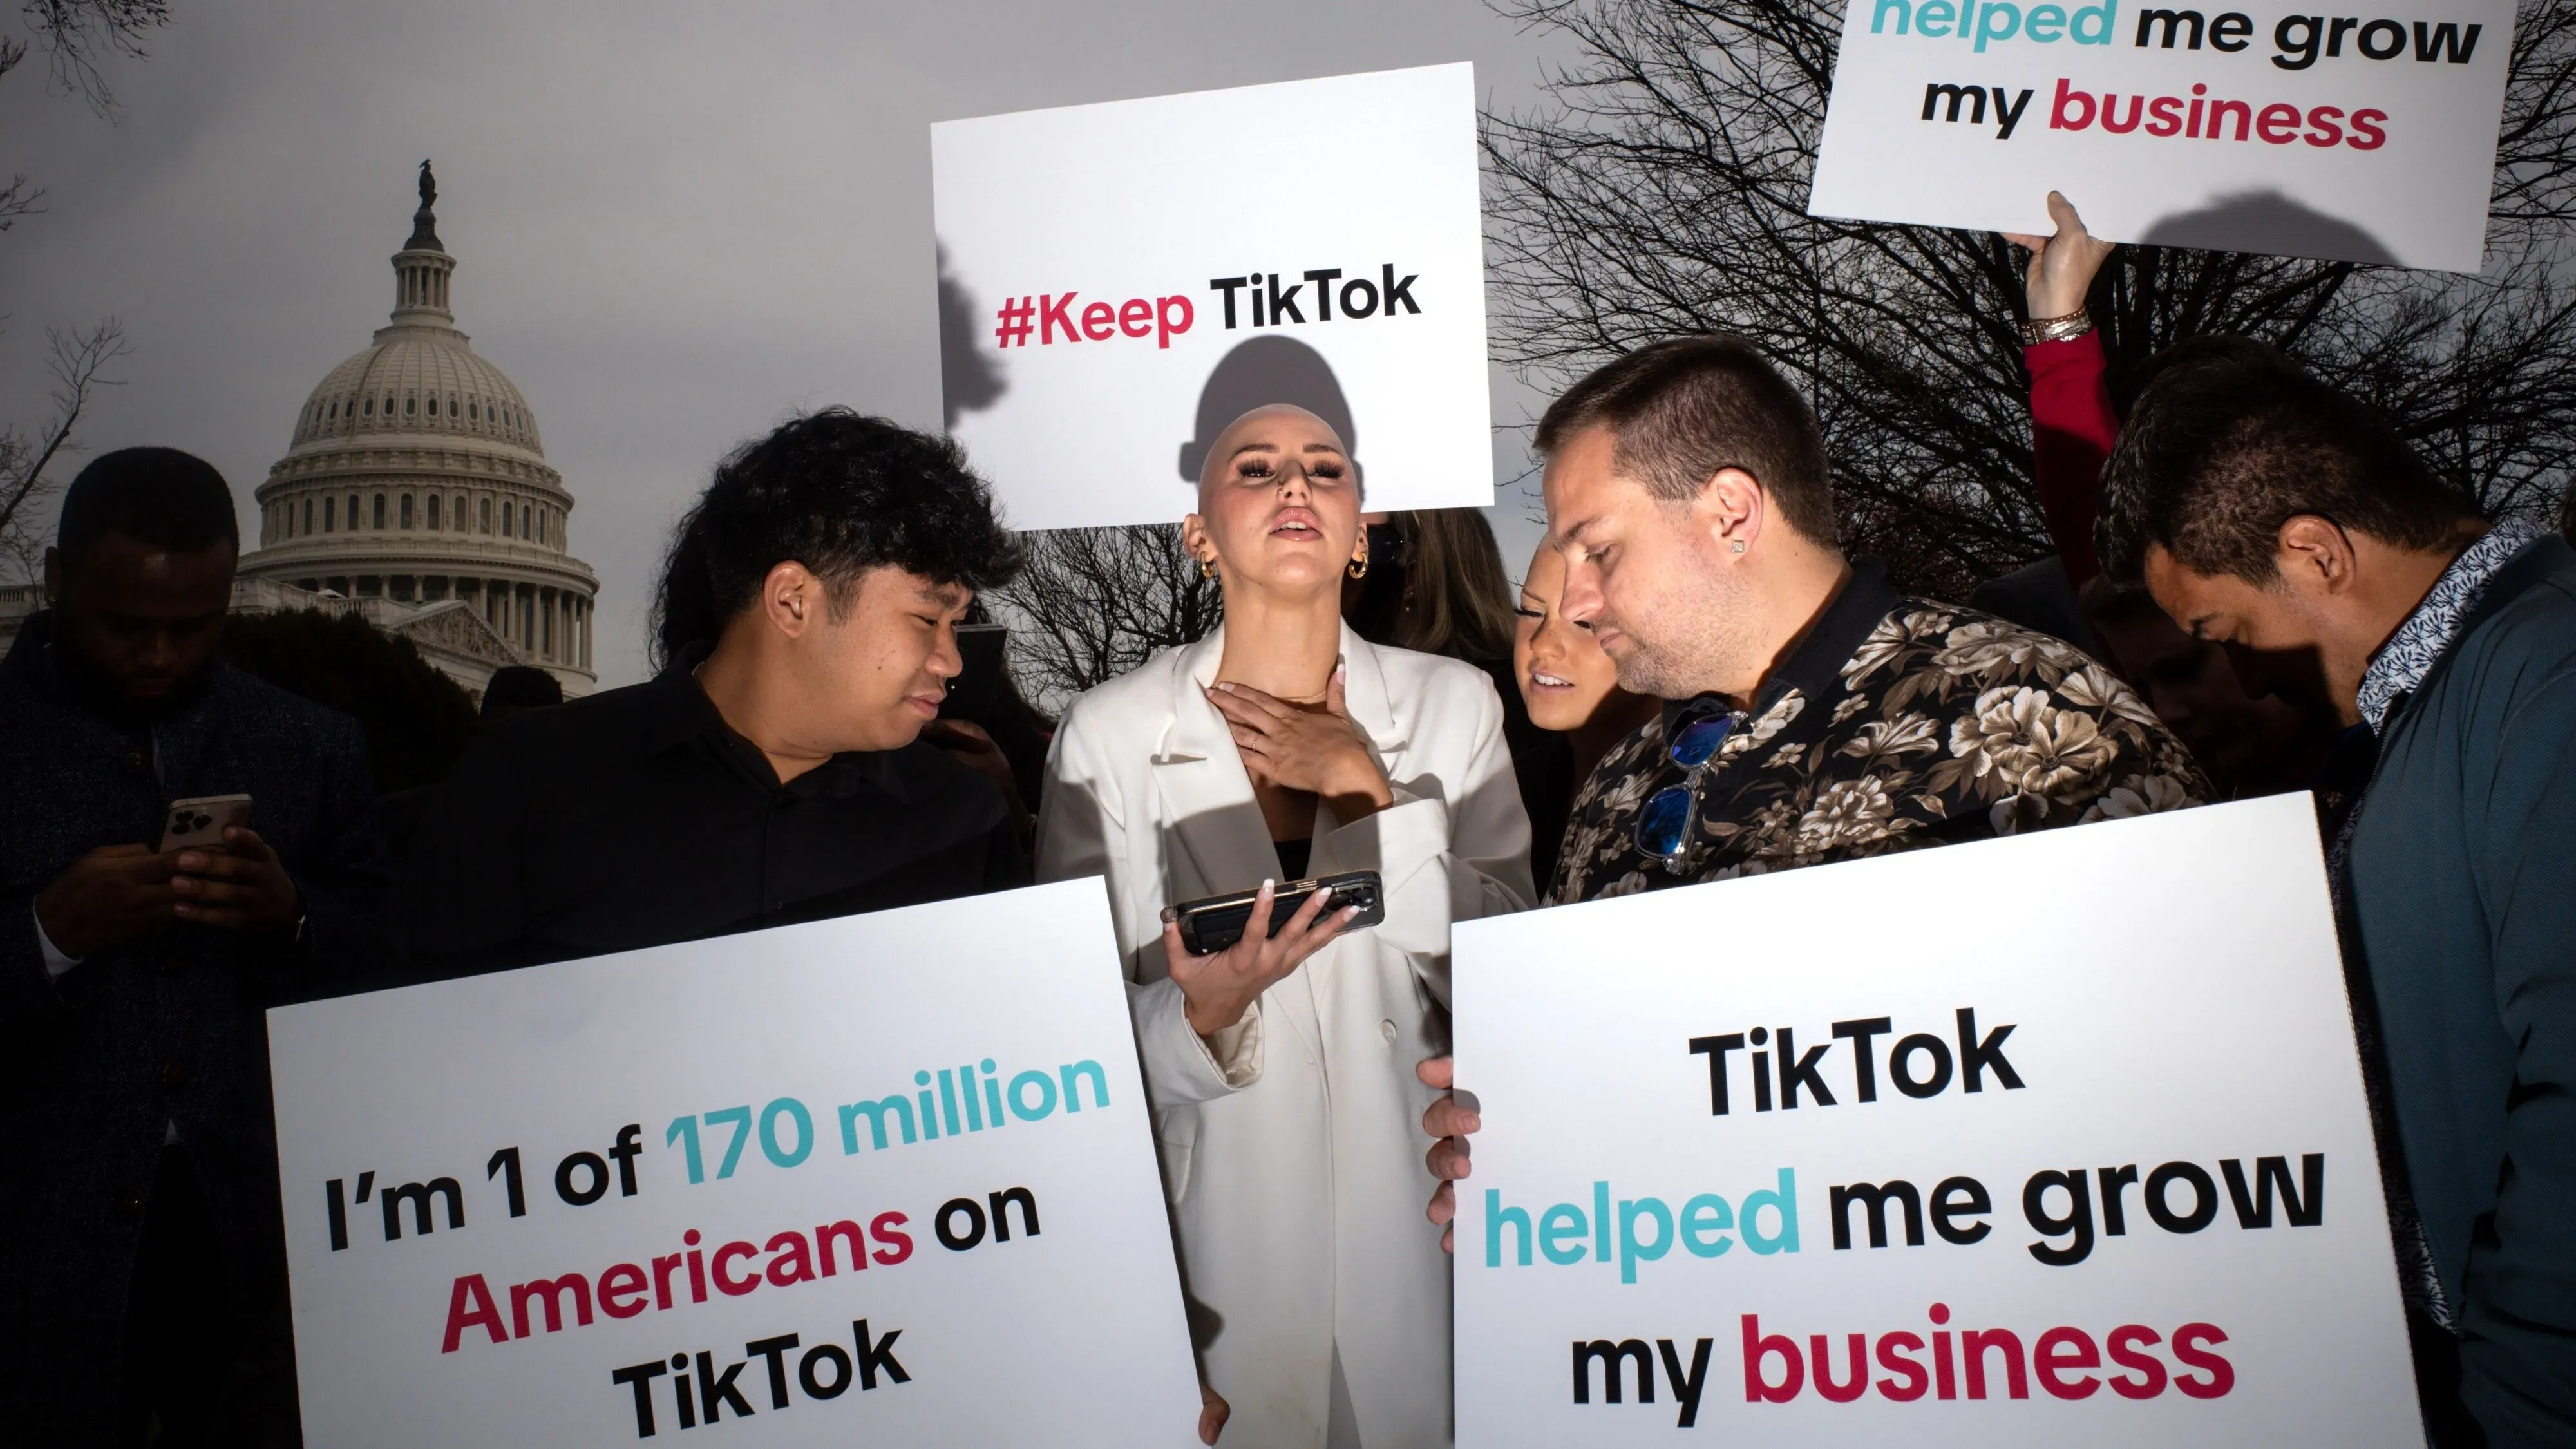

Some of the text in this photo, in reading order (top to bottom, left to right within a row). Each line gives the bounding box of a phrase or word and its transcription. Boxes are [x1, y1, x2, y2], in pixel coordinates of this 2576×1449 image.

[1873, 0, 2483, 71] helped me grow
[1922, 79, 2387, 150] my business
[996, 264, 1421, 349] #Keep TikTok
[1690, 1008, 2025, 1116] TikTok
[488, 1147, 526, 1218] 1
[555, 1124, 643, 1206] of
[667, 1099, 812, 1183] 170
[839, 1059, 1109, 1154] million
[442, 1188, 1041, 1353] Americans on
[1486, 1153, 2324, 1284] helped me grow
[612, 1319, 912, 1439] TikTok
[1573, 1303, 2234, 1428] my business
